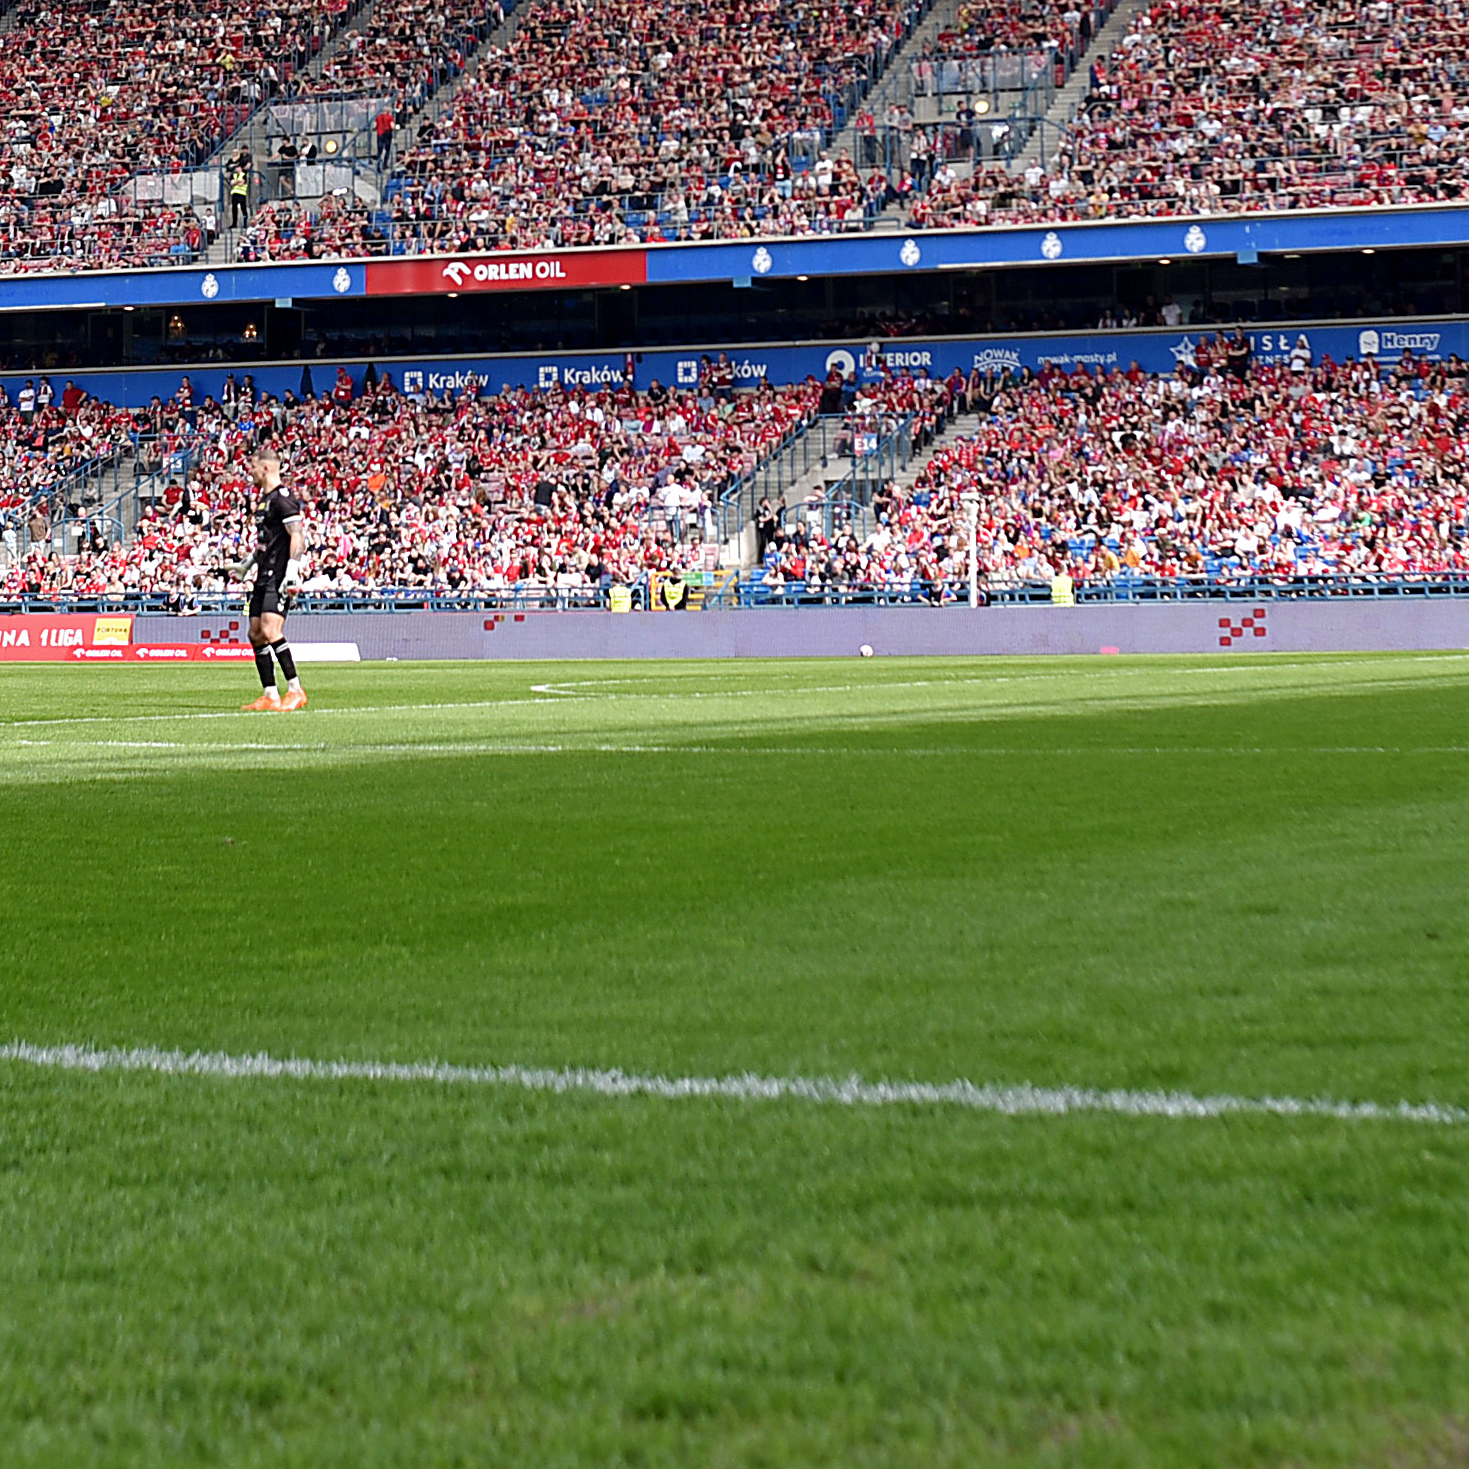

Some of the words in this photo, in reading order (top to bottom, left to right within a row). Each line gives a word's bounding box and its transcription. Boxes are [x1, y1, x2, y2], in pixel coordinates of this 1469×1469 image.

[474, 263, 533, 281] ORLEN
[535, 261, 566, 279] OIL
[1250, 334, 1310, 350] ISŁA
[1382, 332, 1440, 350] Henry
[974, 348, 1019, 364] NOWAK
[564, 365, 624, 384] Kraków
[855, 437, 877, 451] E14
